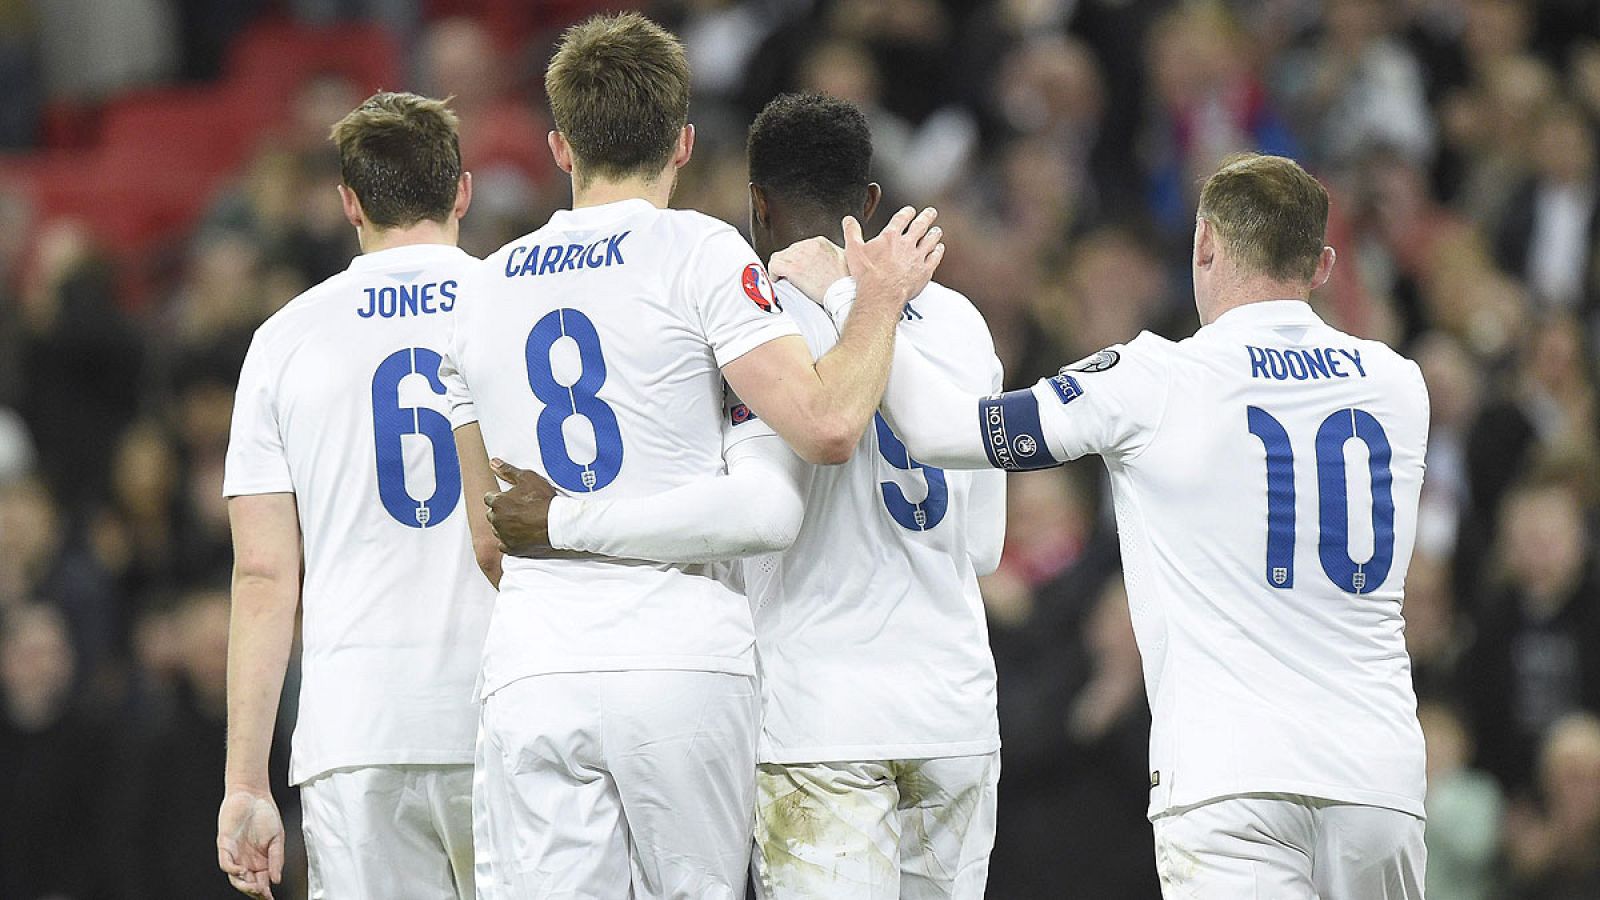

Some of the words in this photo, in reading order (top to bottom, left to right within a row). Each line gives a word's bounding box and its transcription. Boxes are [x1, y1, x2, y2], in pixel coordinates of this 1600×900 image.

[506, 230, 628, 278] CARRICK
[357, 279, 457, 319] JONES
[1248, 345, 1366, 381] ROONEY
[525, 308, 624, 493] 8
[989, 406, 1001, 425] NO
[372, 347, 461, 529] 6
[991, 427, 1005, 446] TO
[1247, 406, 1395, 594] 10
